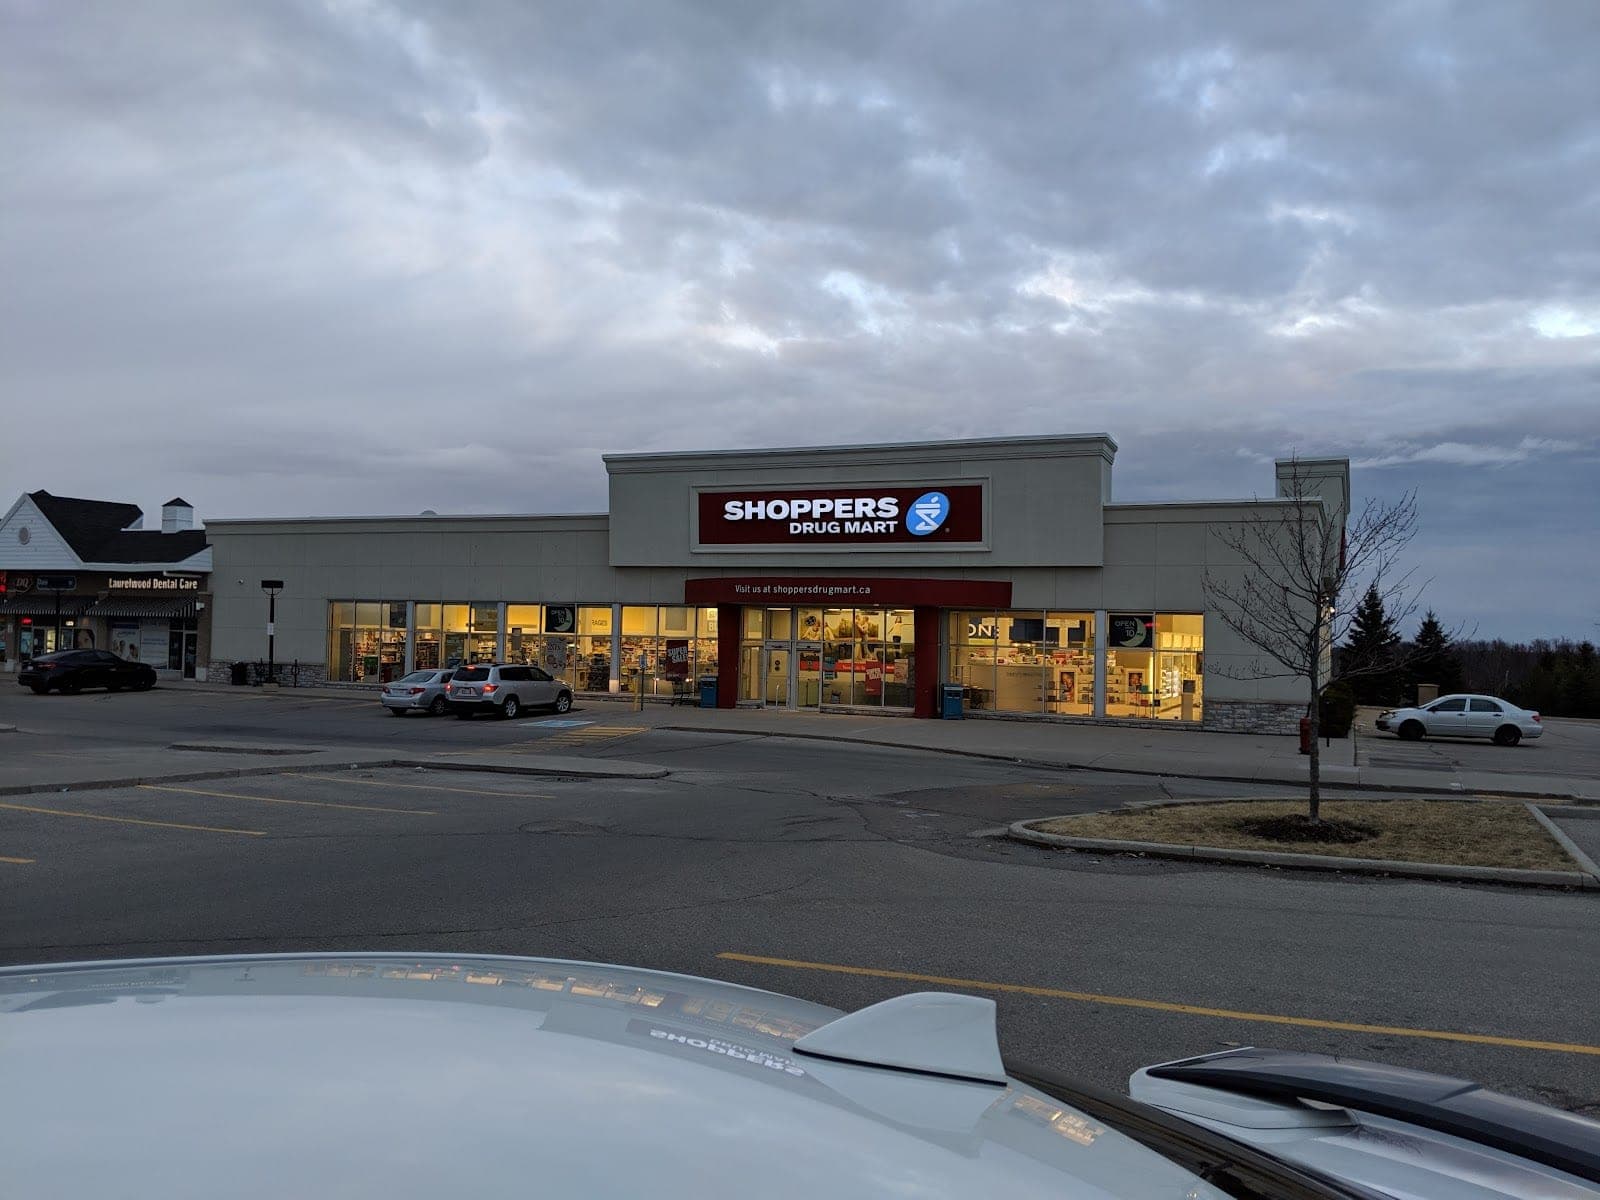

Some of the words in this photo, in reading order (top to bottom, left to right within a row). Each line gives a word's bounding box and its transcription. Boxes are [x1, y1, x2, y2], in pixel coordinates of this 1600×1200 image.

[723, 497, 899, 521] SHOPPERS
[789, 522, 841, 534] DRUG
[844, 521, 899, 534] MART
[108, 578, 152, 589] Laurelwood
[152, 578, 178, 589] Dental
[179, 578, 198, 590] Care
[735, 584, 750, 593] Visit
[763, 584, 771, 593] at
[772, 584, 871, 596] shoppersdrugmart.ca
[1114, 620, 1135, 628] OPEN
